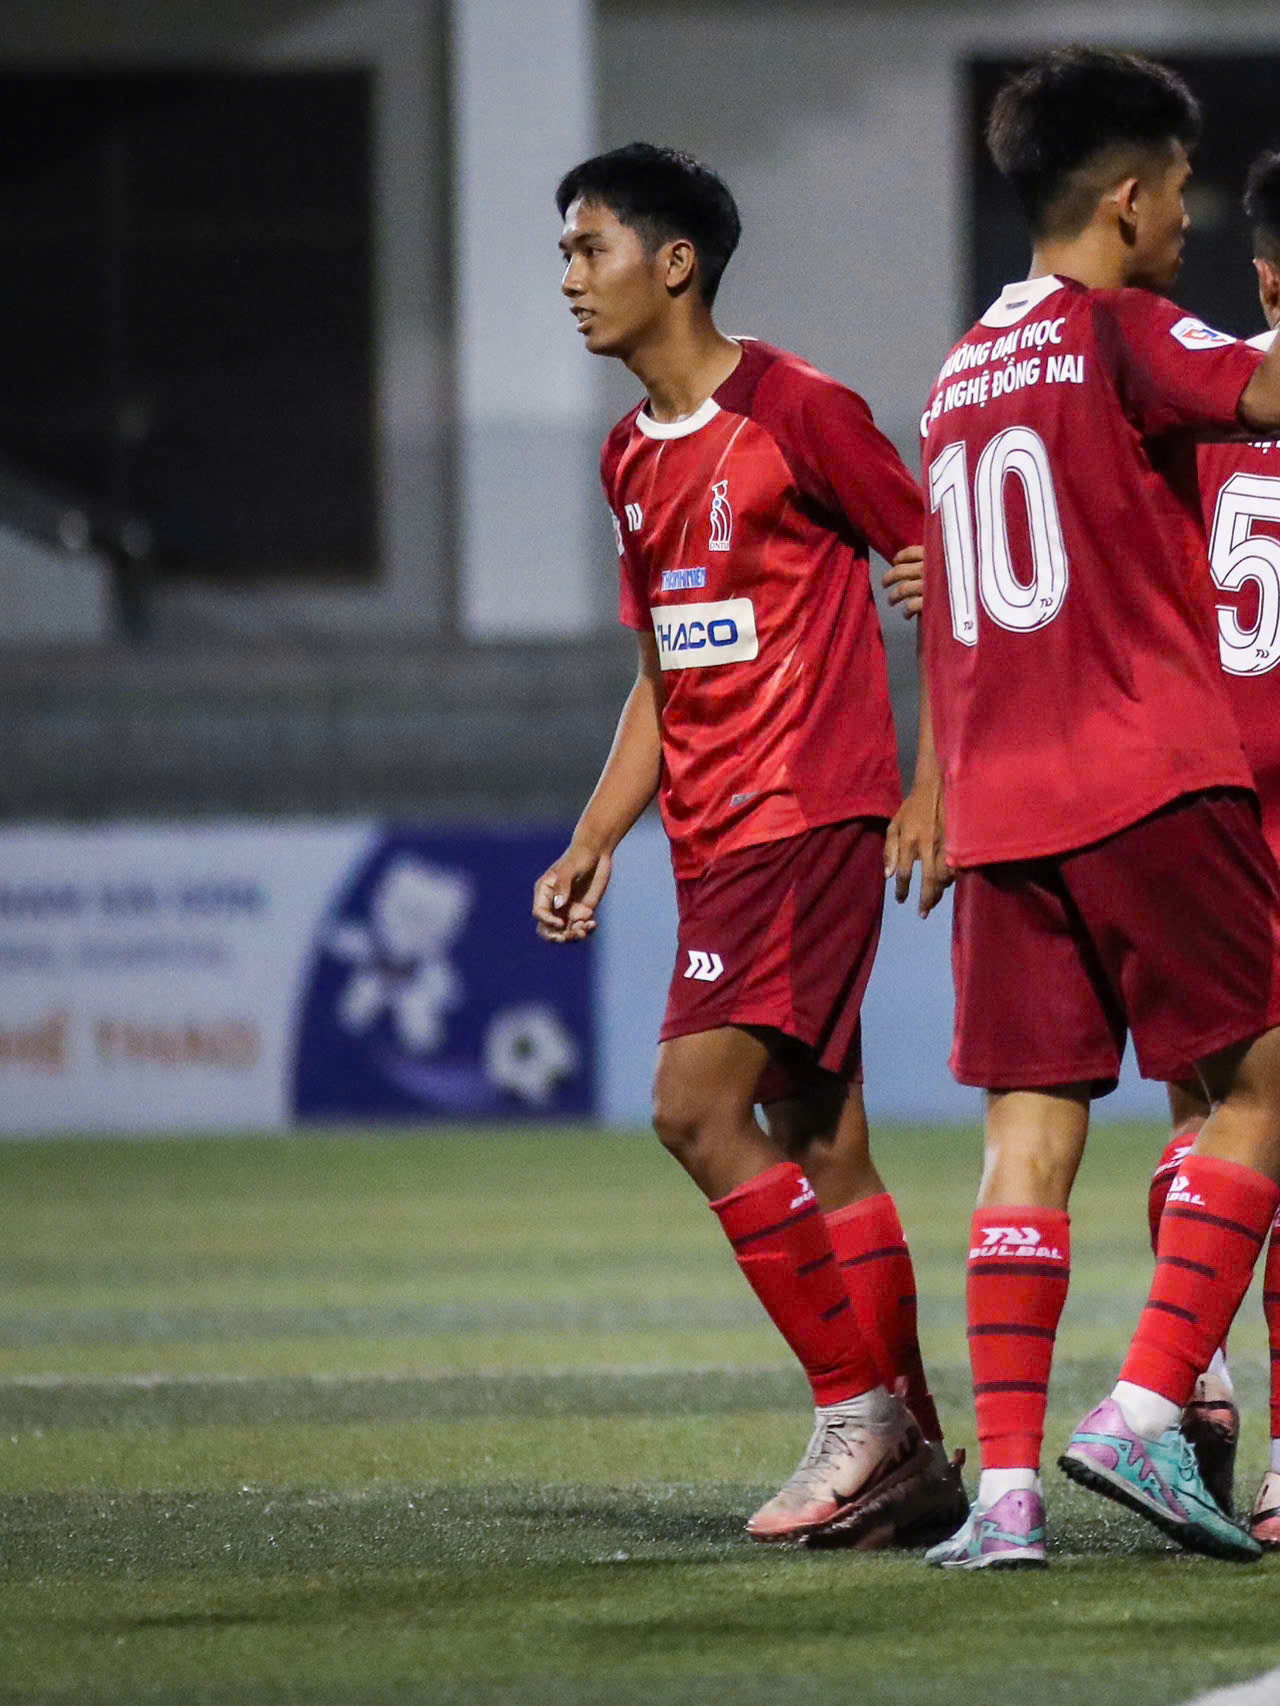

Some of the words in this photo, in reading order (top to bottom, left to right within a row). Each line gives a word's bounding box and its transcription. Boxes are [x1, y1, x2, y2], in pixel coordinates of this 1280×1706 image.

[1021, 317, 1066, 352] HỌC
[944, 370, 990, 408] NGHỆ
[992, 357, 1041, 398] ĐỒNG
[1045, 354, 1084, 384] NAI
[929, 426, 1069, 647] 10
